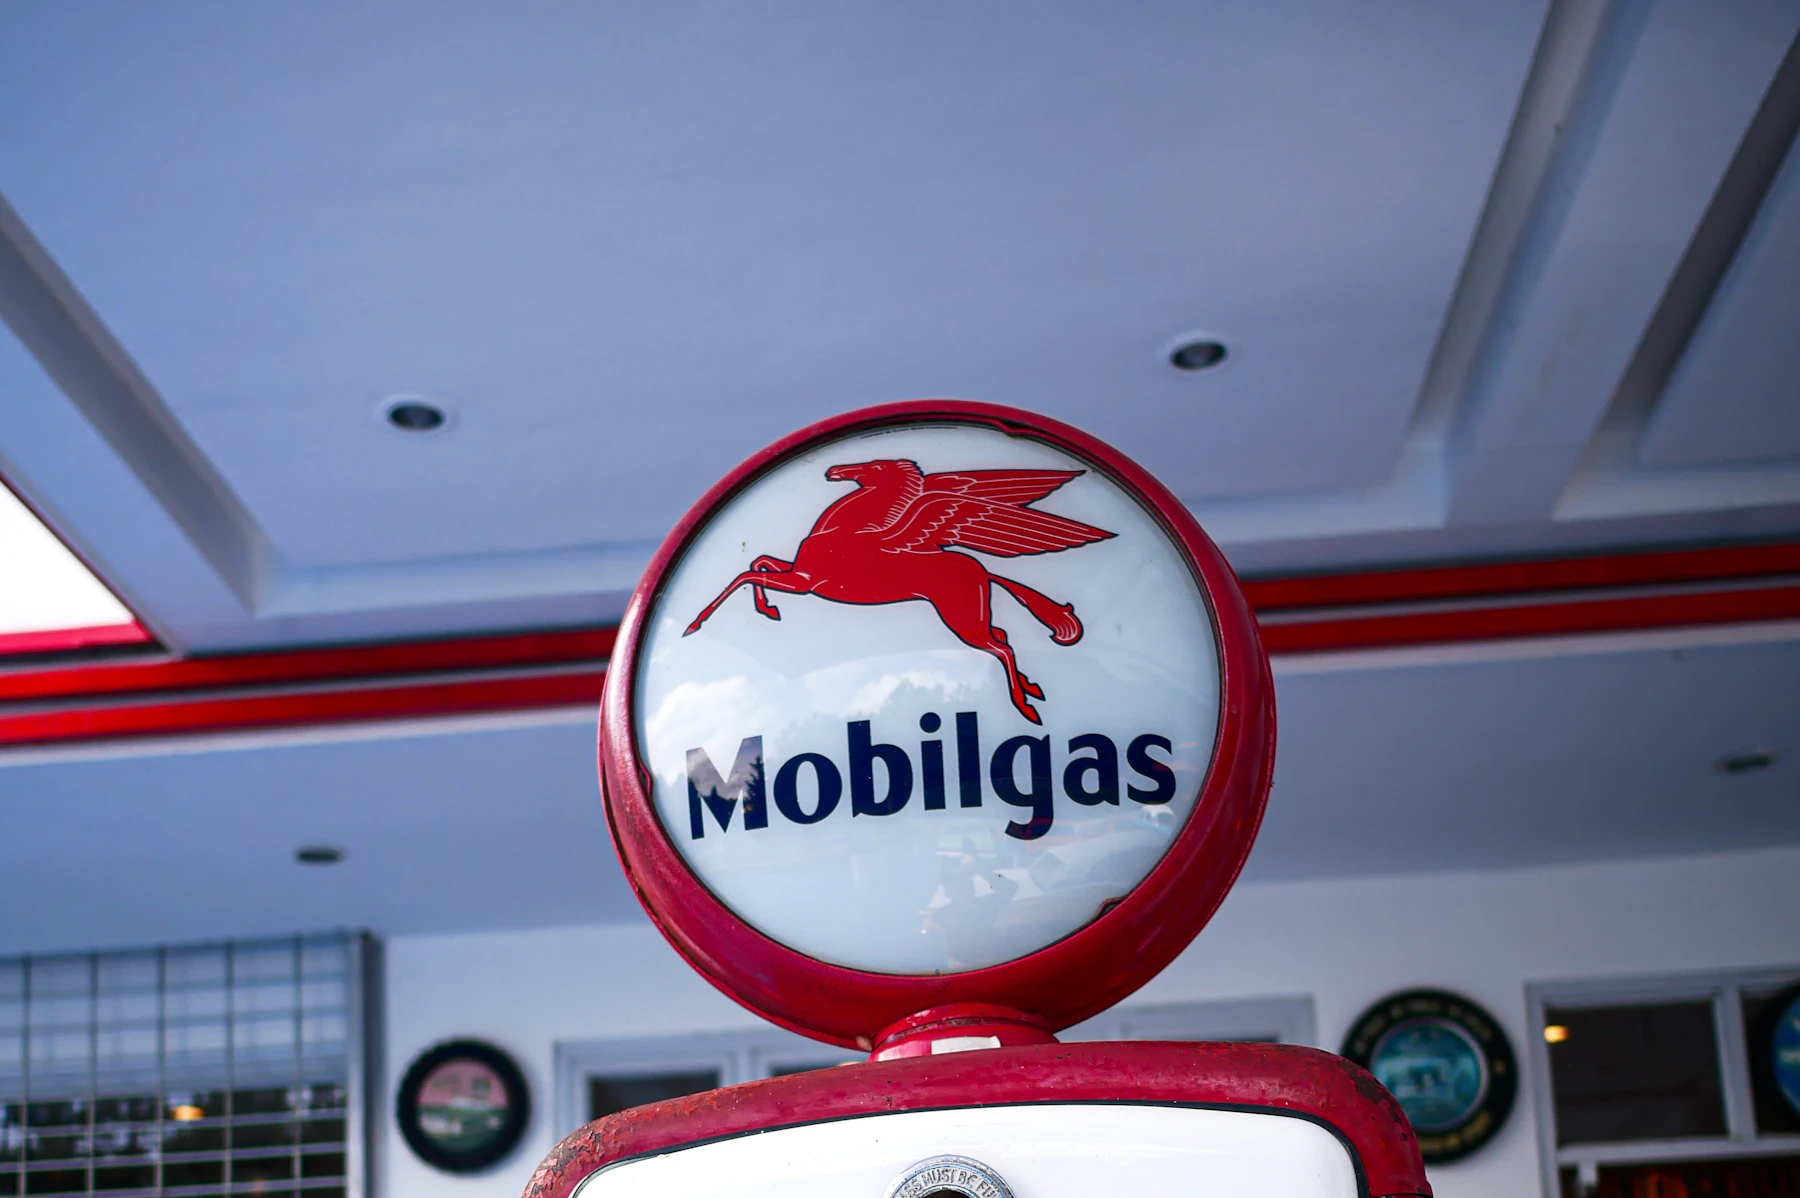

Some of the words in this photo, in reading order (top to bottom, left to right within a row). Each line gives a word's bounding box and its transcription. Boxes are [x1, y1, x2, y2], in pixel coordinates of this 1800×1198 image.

[686, 711, 1176, 840] Mobilgas
[921, 1168, 956, 1184] MUST
[958, 1170, 978, 1188] BE
